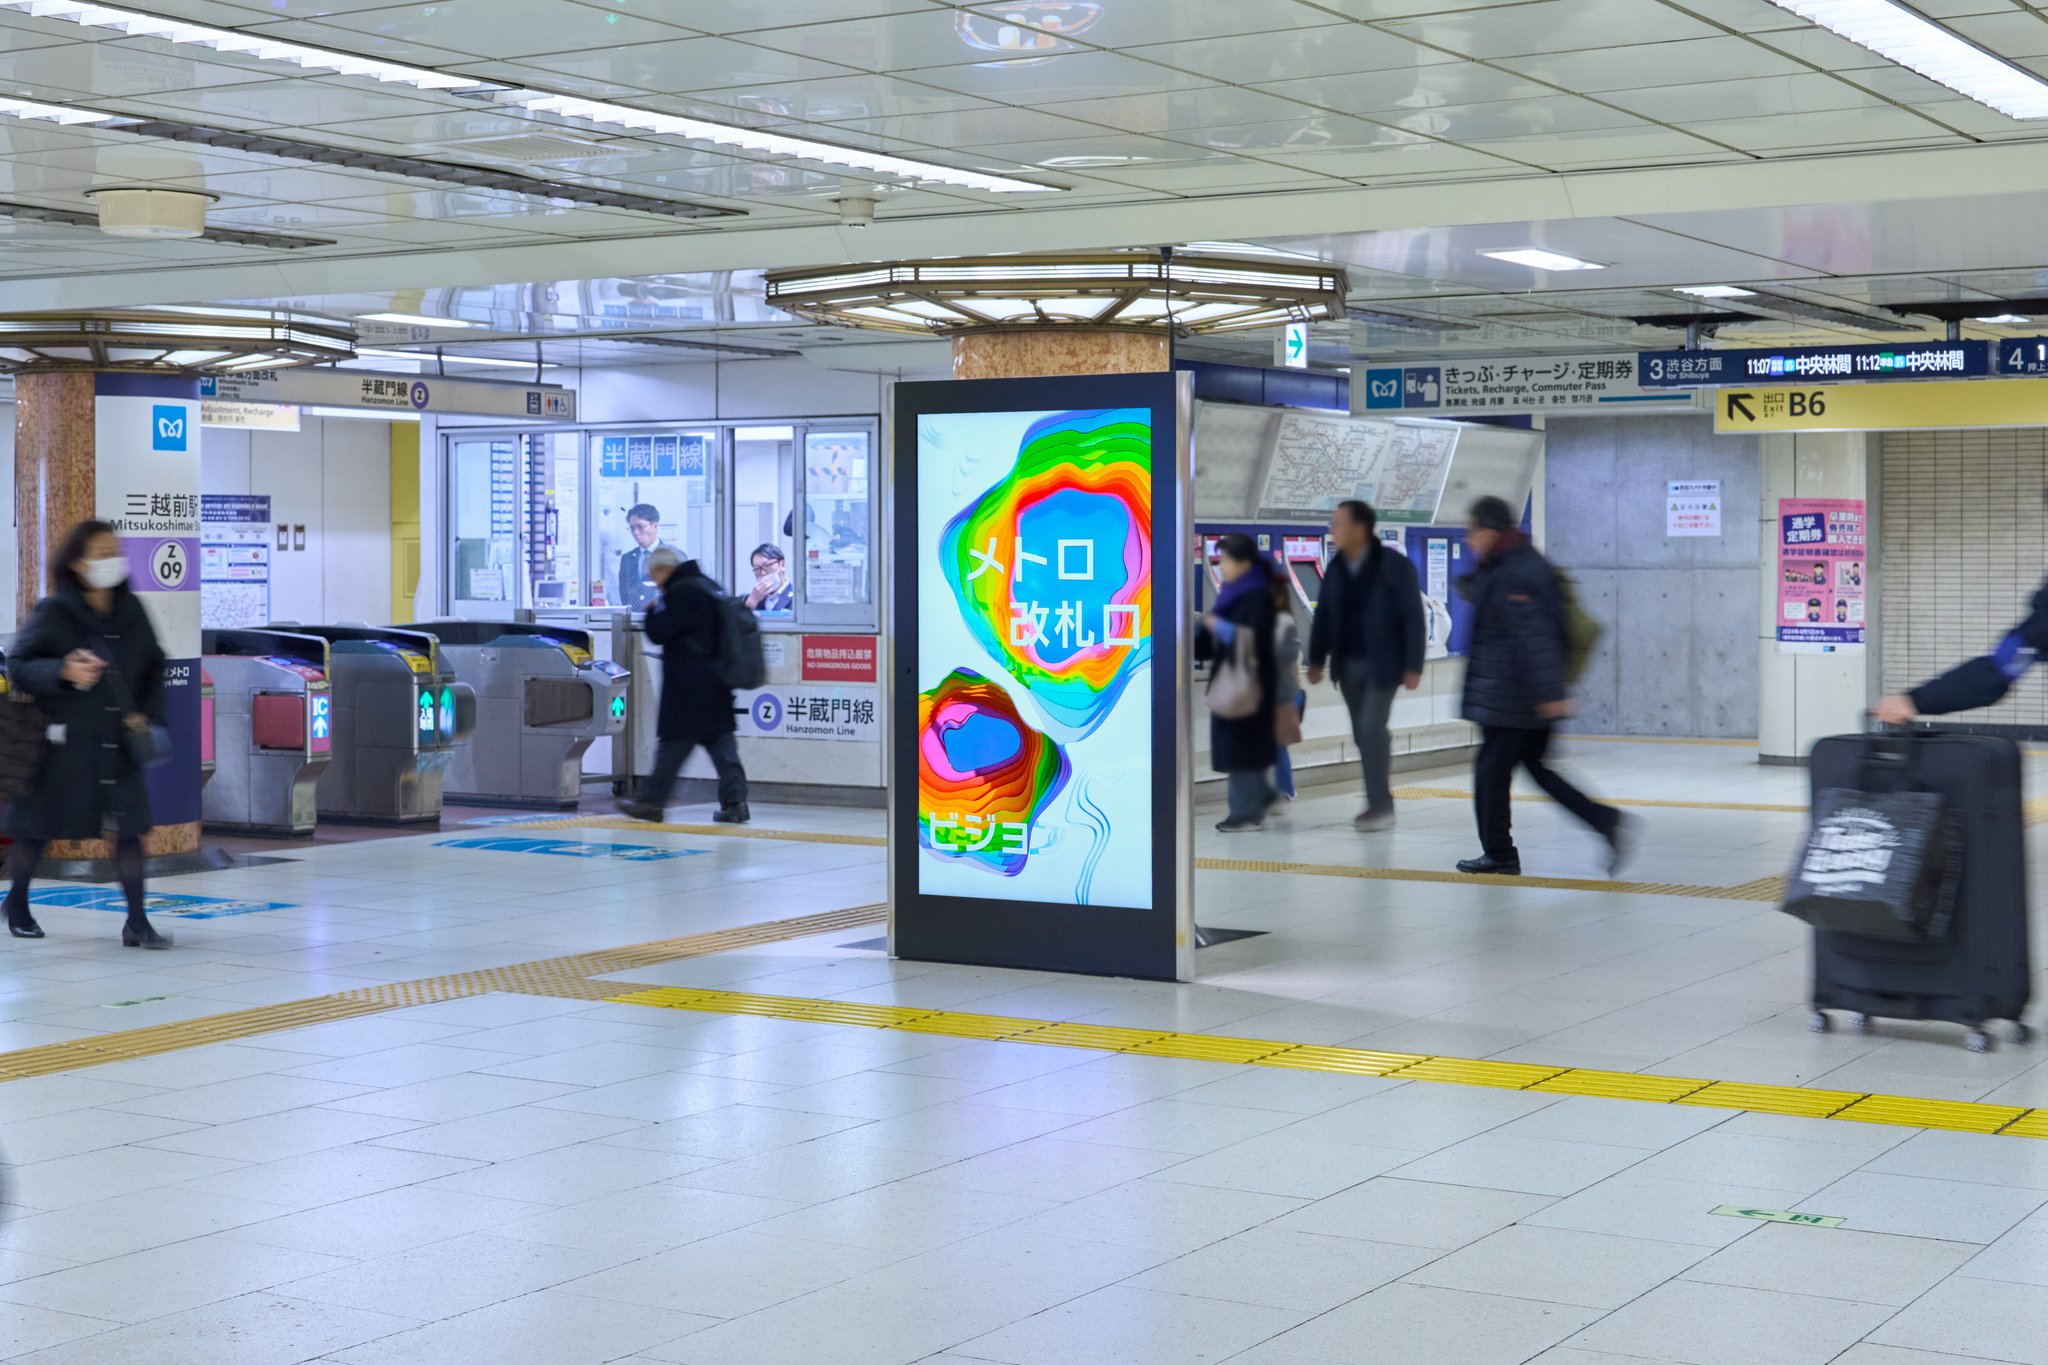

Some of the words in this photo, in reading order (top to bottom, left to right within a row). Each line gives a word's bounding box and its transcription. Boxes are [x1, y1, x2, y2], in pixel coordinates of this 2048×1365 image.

[1796, 354, 1852, 375] 中央林間
[1906, 350, 1964, 372] 中央林間
[2008, 347, 2024, 370] 4
[1650, 359, 1663, 380] 3
[1666, 357, 1722, 372] 渋谷方面
[1679, 372, 1709, 380] Shibuya
[361, 379, 408, 397] 半蔵門線
[417, 390, 423, 400] Z
[1445, 386, 1480, 395] Tickets,
[1483, 384, 1529, 396] Recharge,
[1532, 382, 1582, 392] Commuter
[1585, 381, 1607, 390] Pass
[361, 395, 395, 406] Hanzomon
[396, 398, 409, 407] Line
[1763, 392, 1784, 404] 出口
[1789, 391, 1825, 417] B6
[244, 407, 274, 417] Recharge
[1764, 405, 1784, 413] Exit
[604, 441, 703, 471] 半蔵門線
[110, 519, 194, 532] Mitsukoshimae
[168, 545, 176, 558] Z
[967, 537, 1094, 582] メトロ
[160, 562, 182, 579] 09
[1010, 600, 1140, 650] 改札口
[806, 661, 816, 669] NO
[851, 662, 872, 670] GOODS
[313, 699, 328, 715] IC
[763, 705, 772, 718] Z
[787, 696, 874, 725] 半蔵門線
[786, 724, 834, 734] Hanzomon
[837, 726, 855, 736] Line
